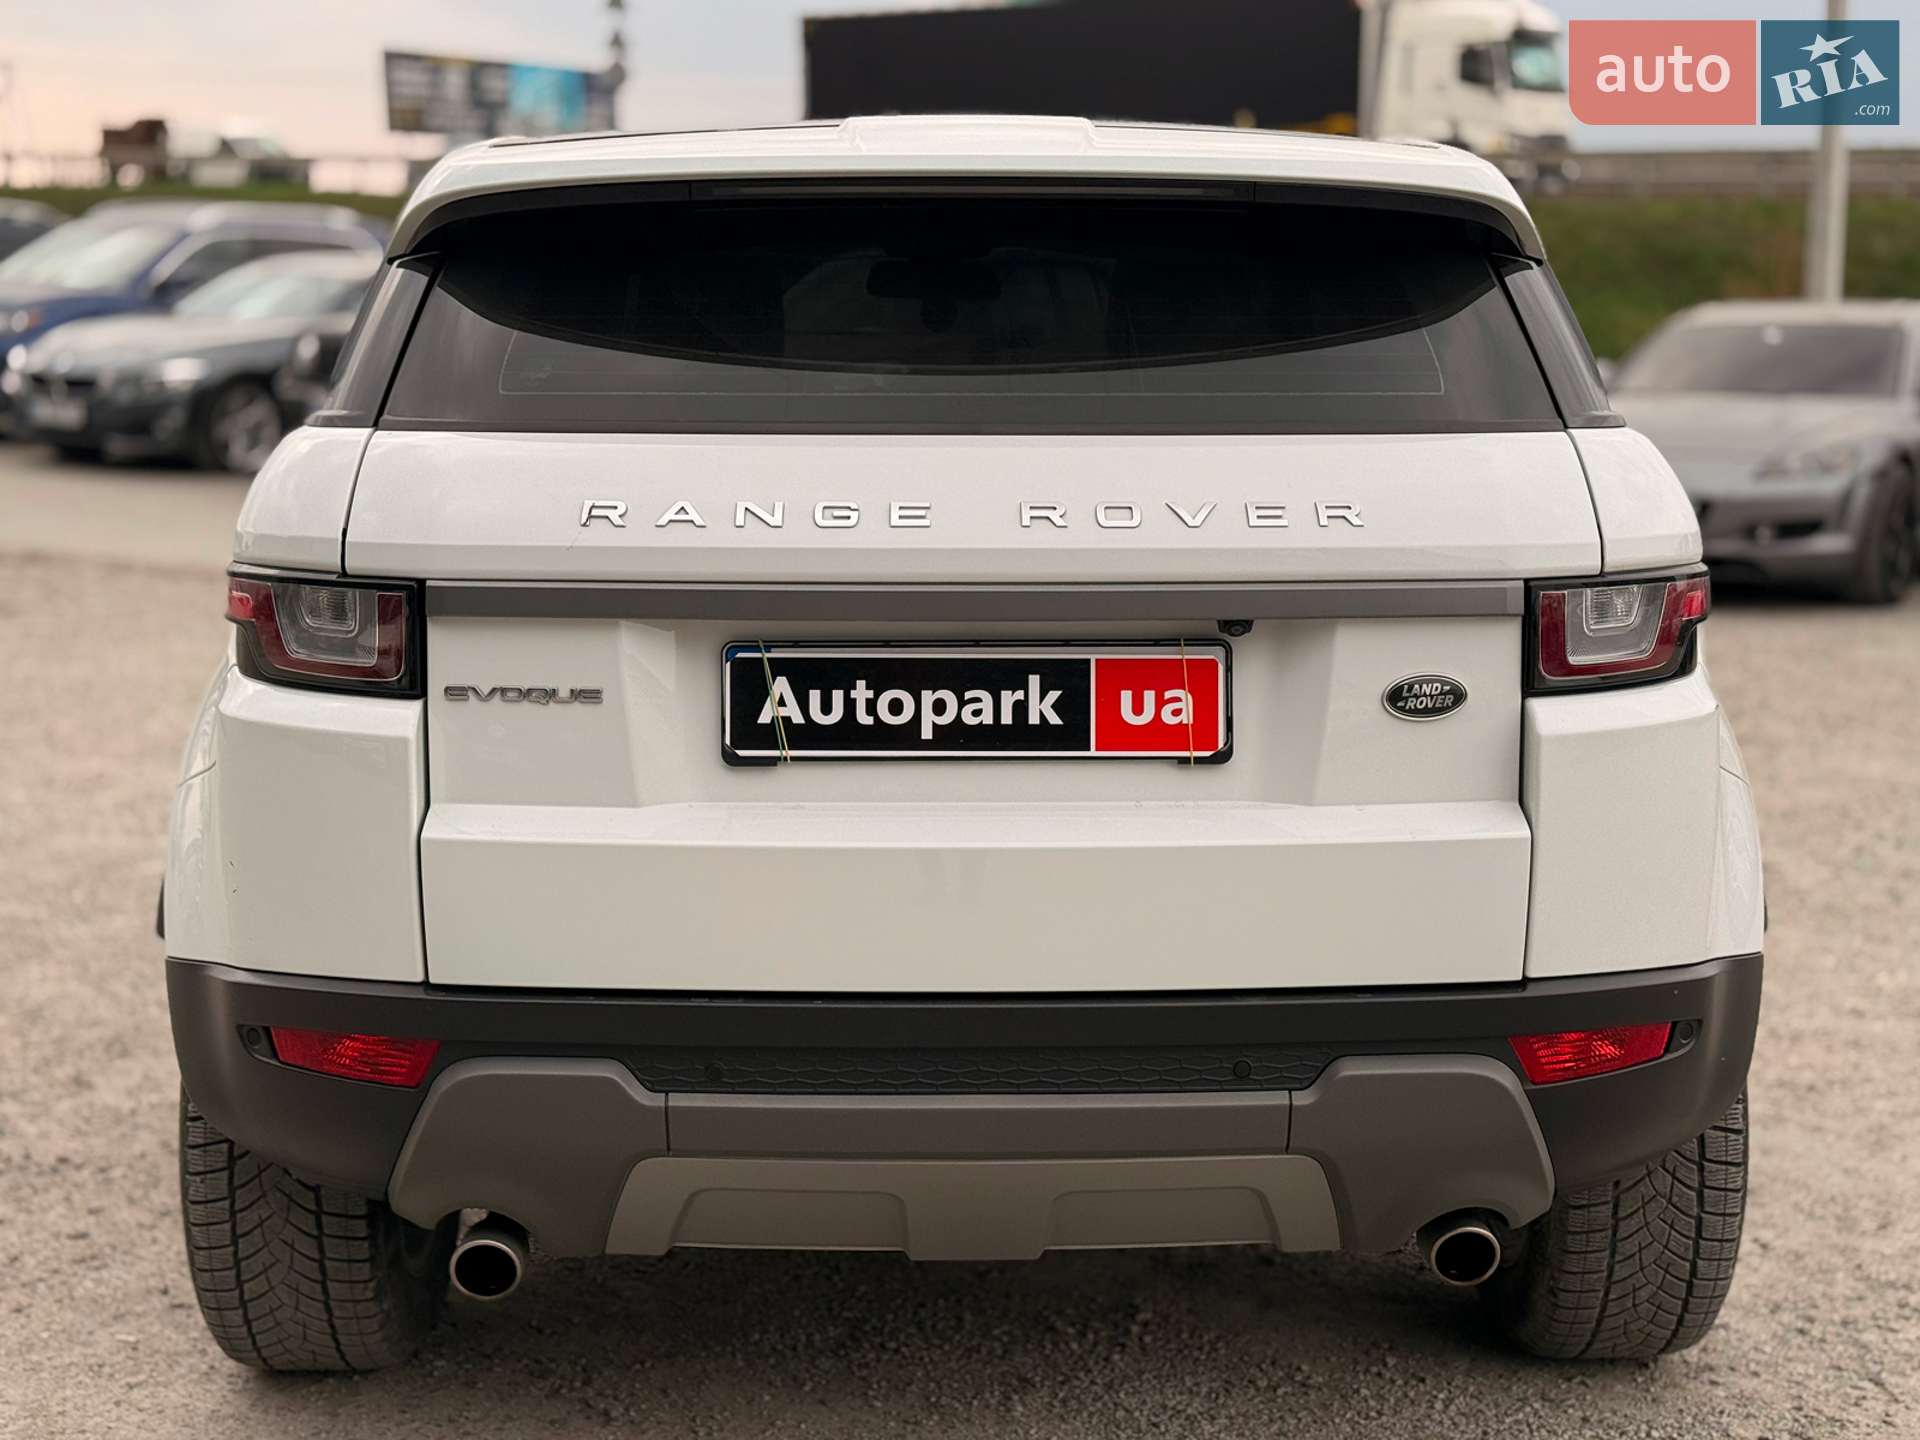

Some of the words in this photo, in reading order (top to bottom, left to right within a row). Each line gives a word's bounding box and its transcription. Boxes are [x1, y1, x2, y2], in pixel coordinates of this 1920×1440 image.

[579, 499, 932, 528] RANGE
[1019, 500, 1365, 528] ROVER
[443, 683, 604, 706] EVOQUE
[1401, 682, 1443, 697] LAND
[756, 673, 1065, 740] Autopark
[1119, 687, 1195, 727] ua
[1404, 694, 1455, 710] ROVER
